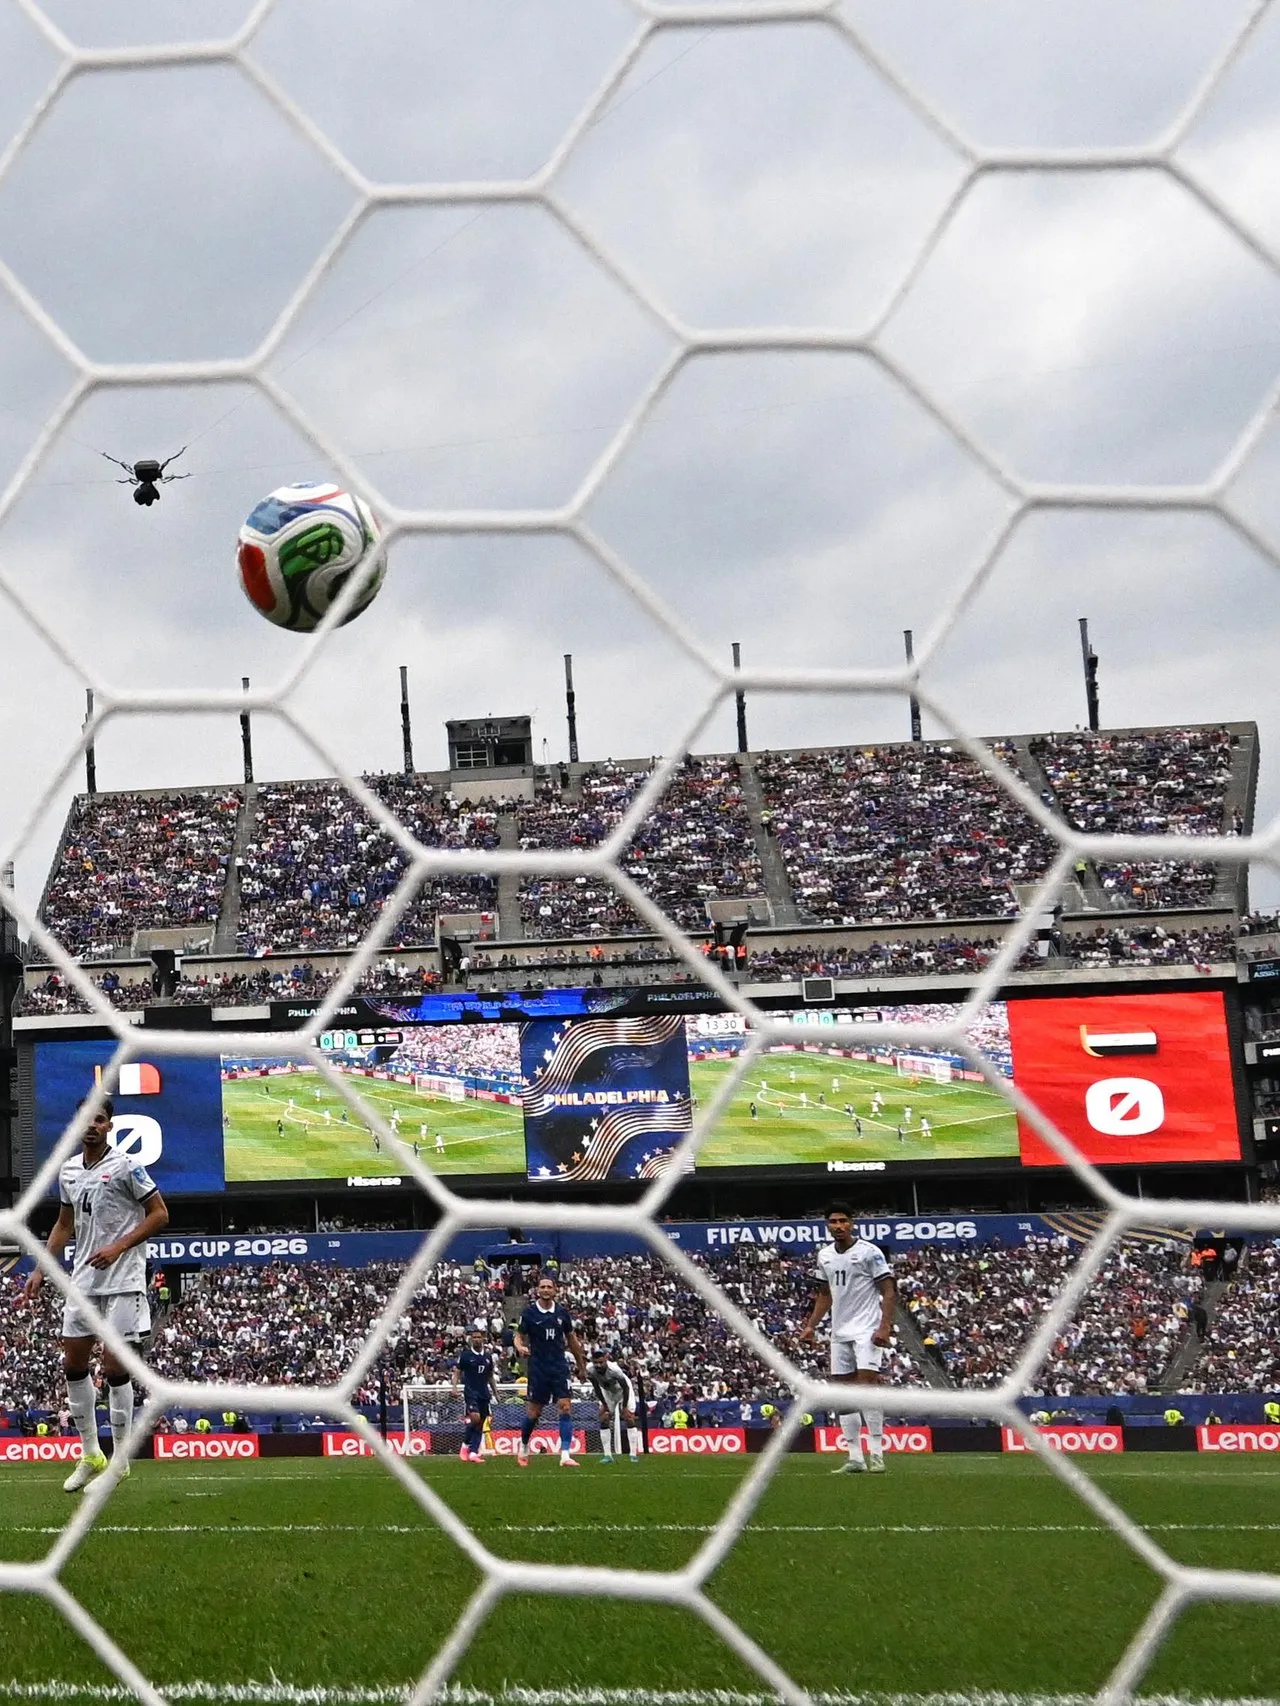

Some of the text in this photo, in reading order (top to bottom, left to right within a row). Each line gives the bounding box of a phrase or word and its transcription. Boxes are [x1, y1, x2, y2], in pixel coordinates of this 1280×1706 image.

[287, 1006, 358, 1018] PHILADPHIA
[543, 1089, 670, 1107] PHILADELPHIA
[81, 1191, 92, 1217] 4
[707, 1227, 743, 1245] FIFA
[894, 1221, 977, 1240] 2026
[145, 1238, 308, 1259] RLD CUP 2026
[835, 1270, 846, 1287] 11
[545, 1328, 556, 1341] 14
[158, 1437, 255, 1458] Lenovo
[648, 1434, 741, 1453] enovo
[1007, 1428, 1118, 1451] Lnovo
[1201, 1427, 1280, 1450] Leno
